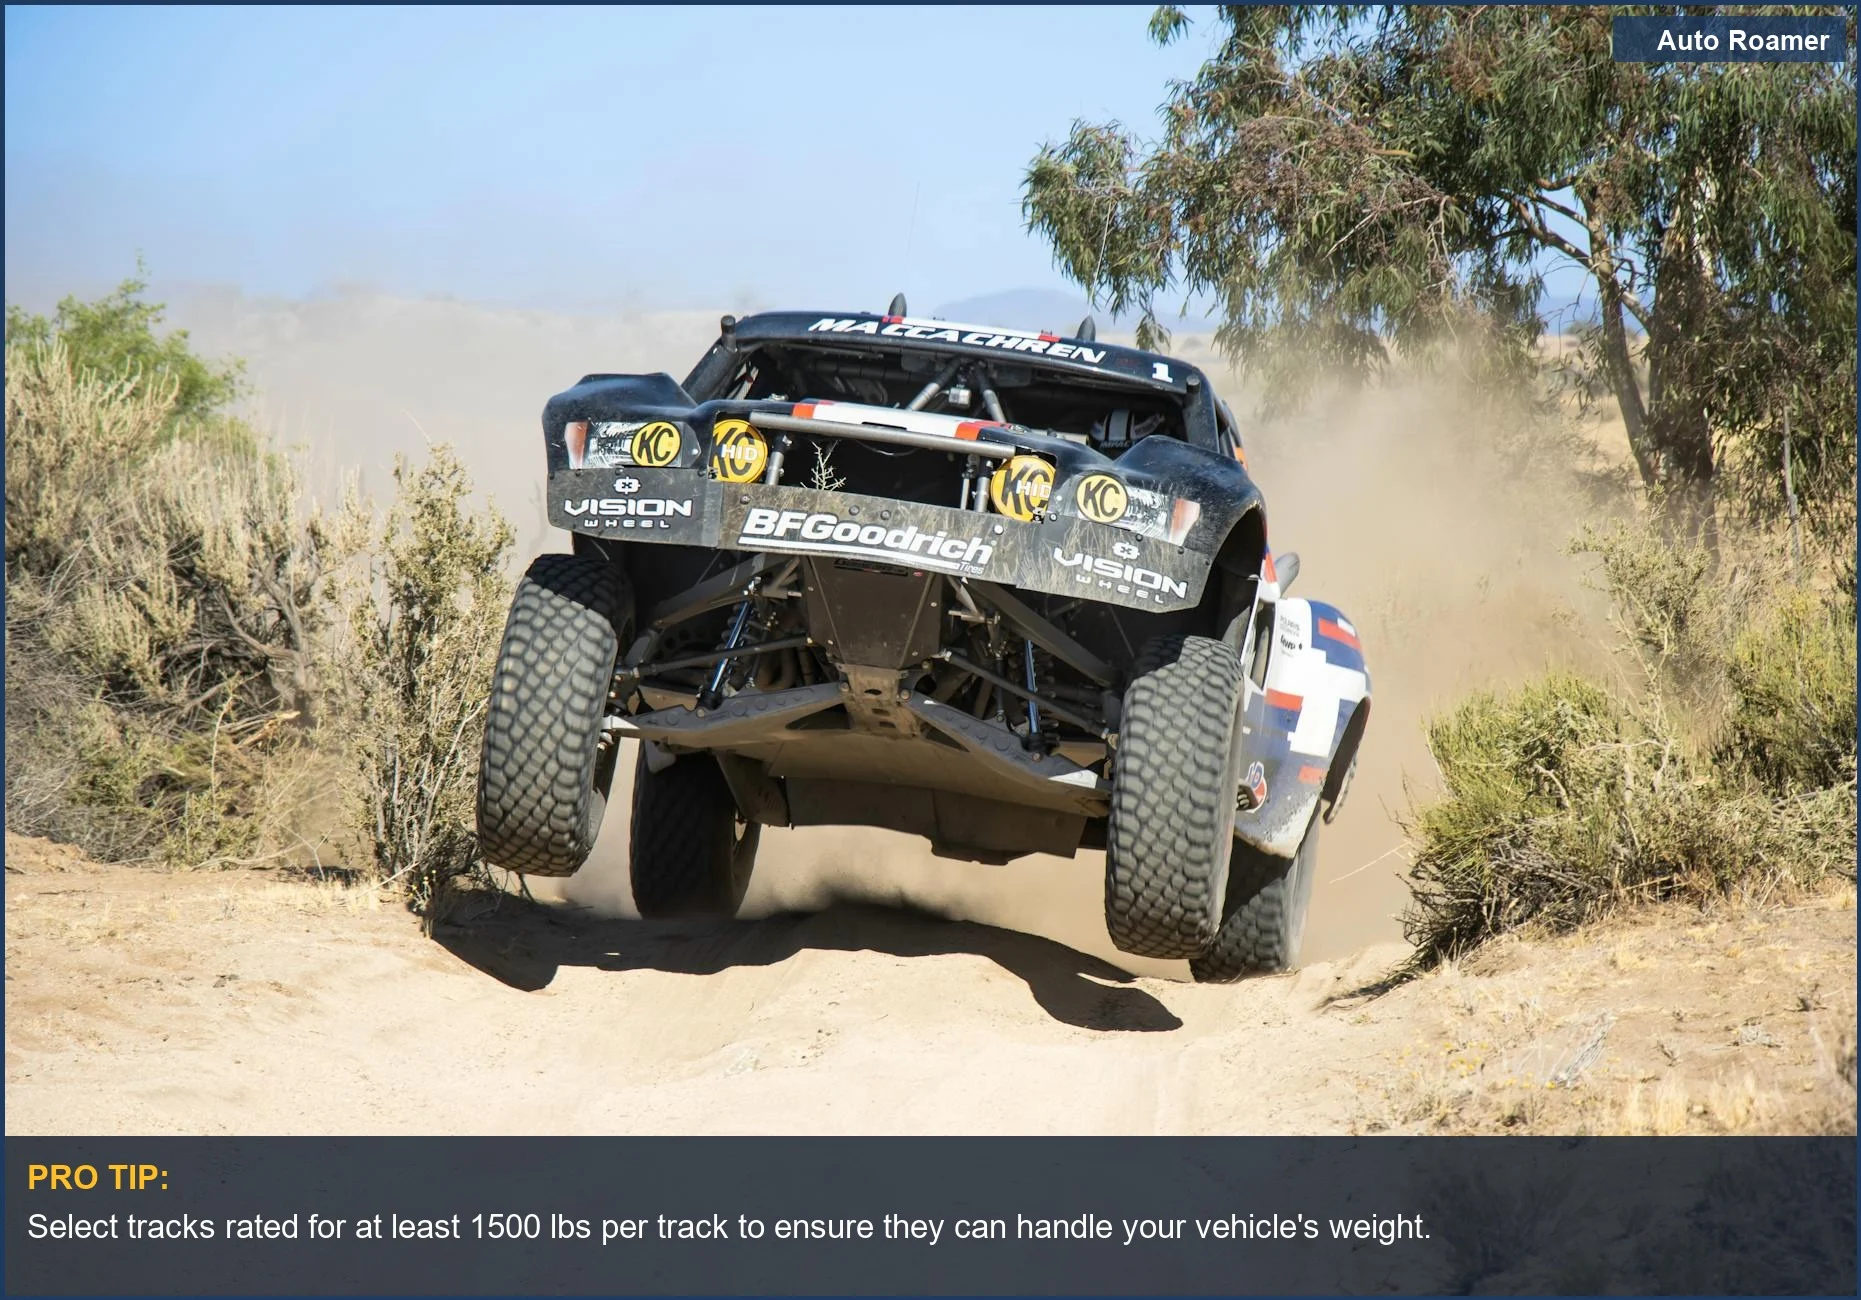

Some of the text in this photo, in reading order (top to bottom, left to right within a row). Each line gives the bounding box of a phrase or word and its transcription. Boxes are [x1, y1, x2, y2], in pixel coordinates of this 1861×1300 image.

[808, 318, 1107, 364] MACCACHREN
[1151, 362, 1173, 383] 1
[638, 425, 675, 465] KC
[709, 427, 756, 478] KC
[721, 443, 758, 462] HID
[564, 498, 693, 517] VISION
[1001, 463, 1051, 515] KC
[1083, 479, 1121, 519] KC
[583, 519, 671, 529] WHEEL
[742, 507, 994, 565] BFGoodrich
[957, 560, 985, 575] Tires
[1053, 546, 1188, 600] VISION
[1075, 573, 1165, 604] WHEEL
